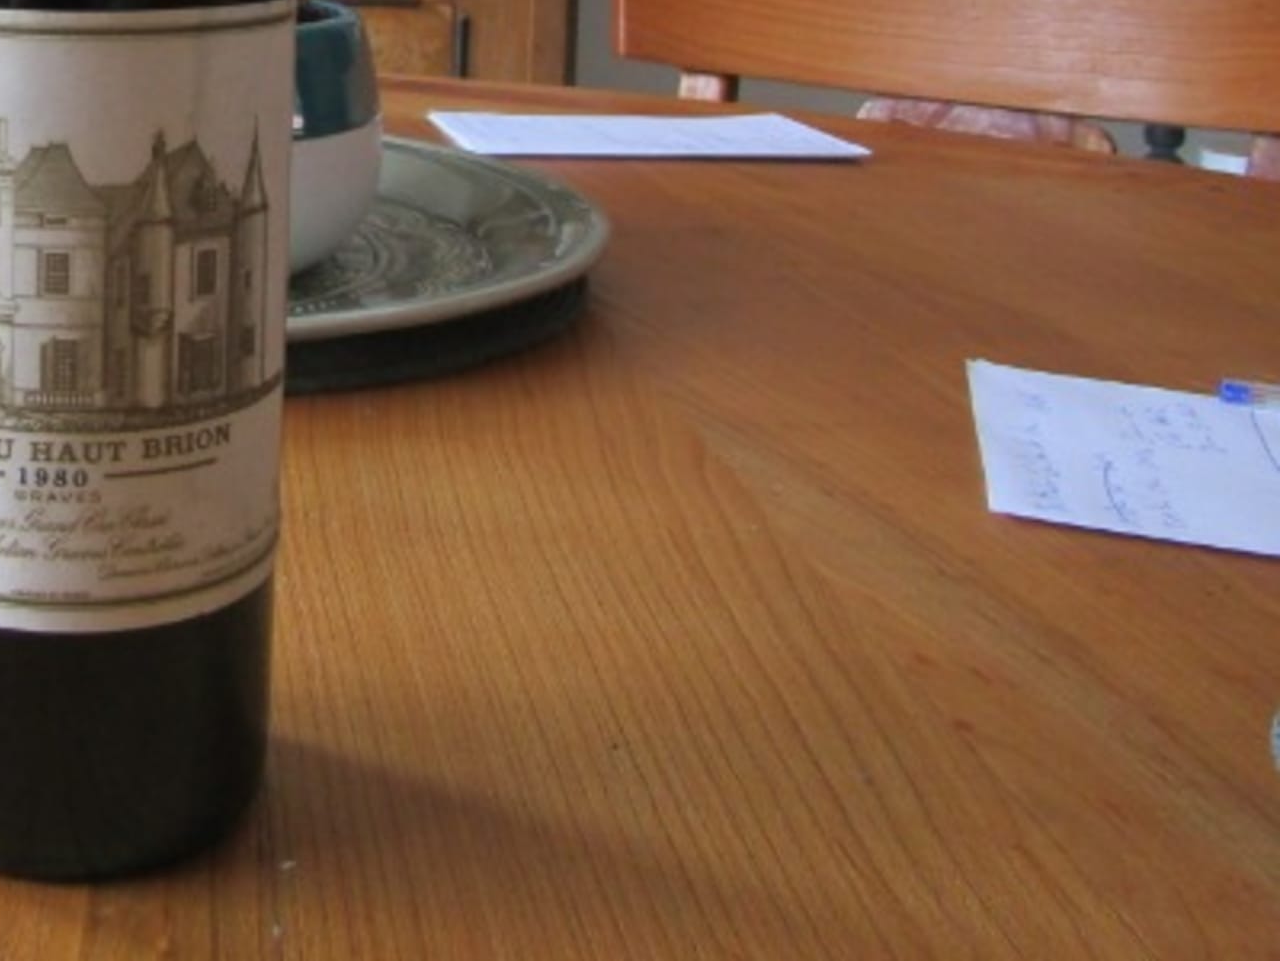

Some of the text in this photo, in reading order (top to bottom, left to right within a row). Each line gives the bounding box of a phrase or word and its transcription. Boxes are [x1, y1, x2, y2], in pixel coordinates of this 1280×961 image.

[29, 441, 126, 464] HAUT
[142, 423, 231, 460] BRION
[17, 467, 89, 488] 1980
[14, 489, 102, 504] GRAVES
